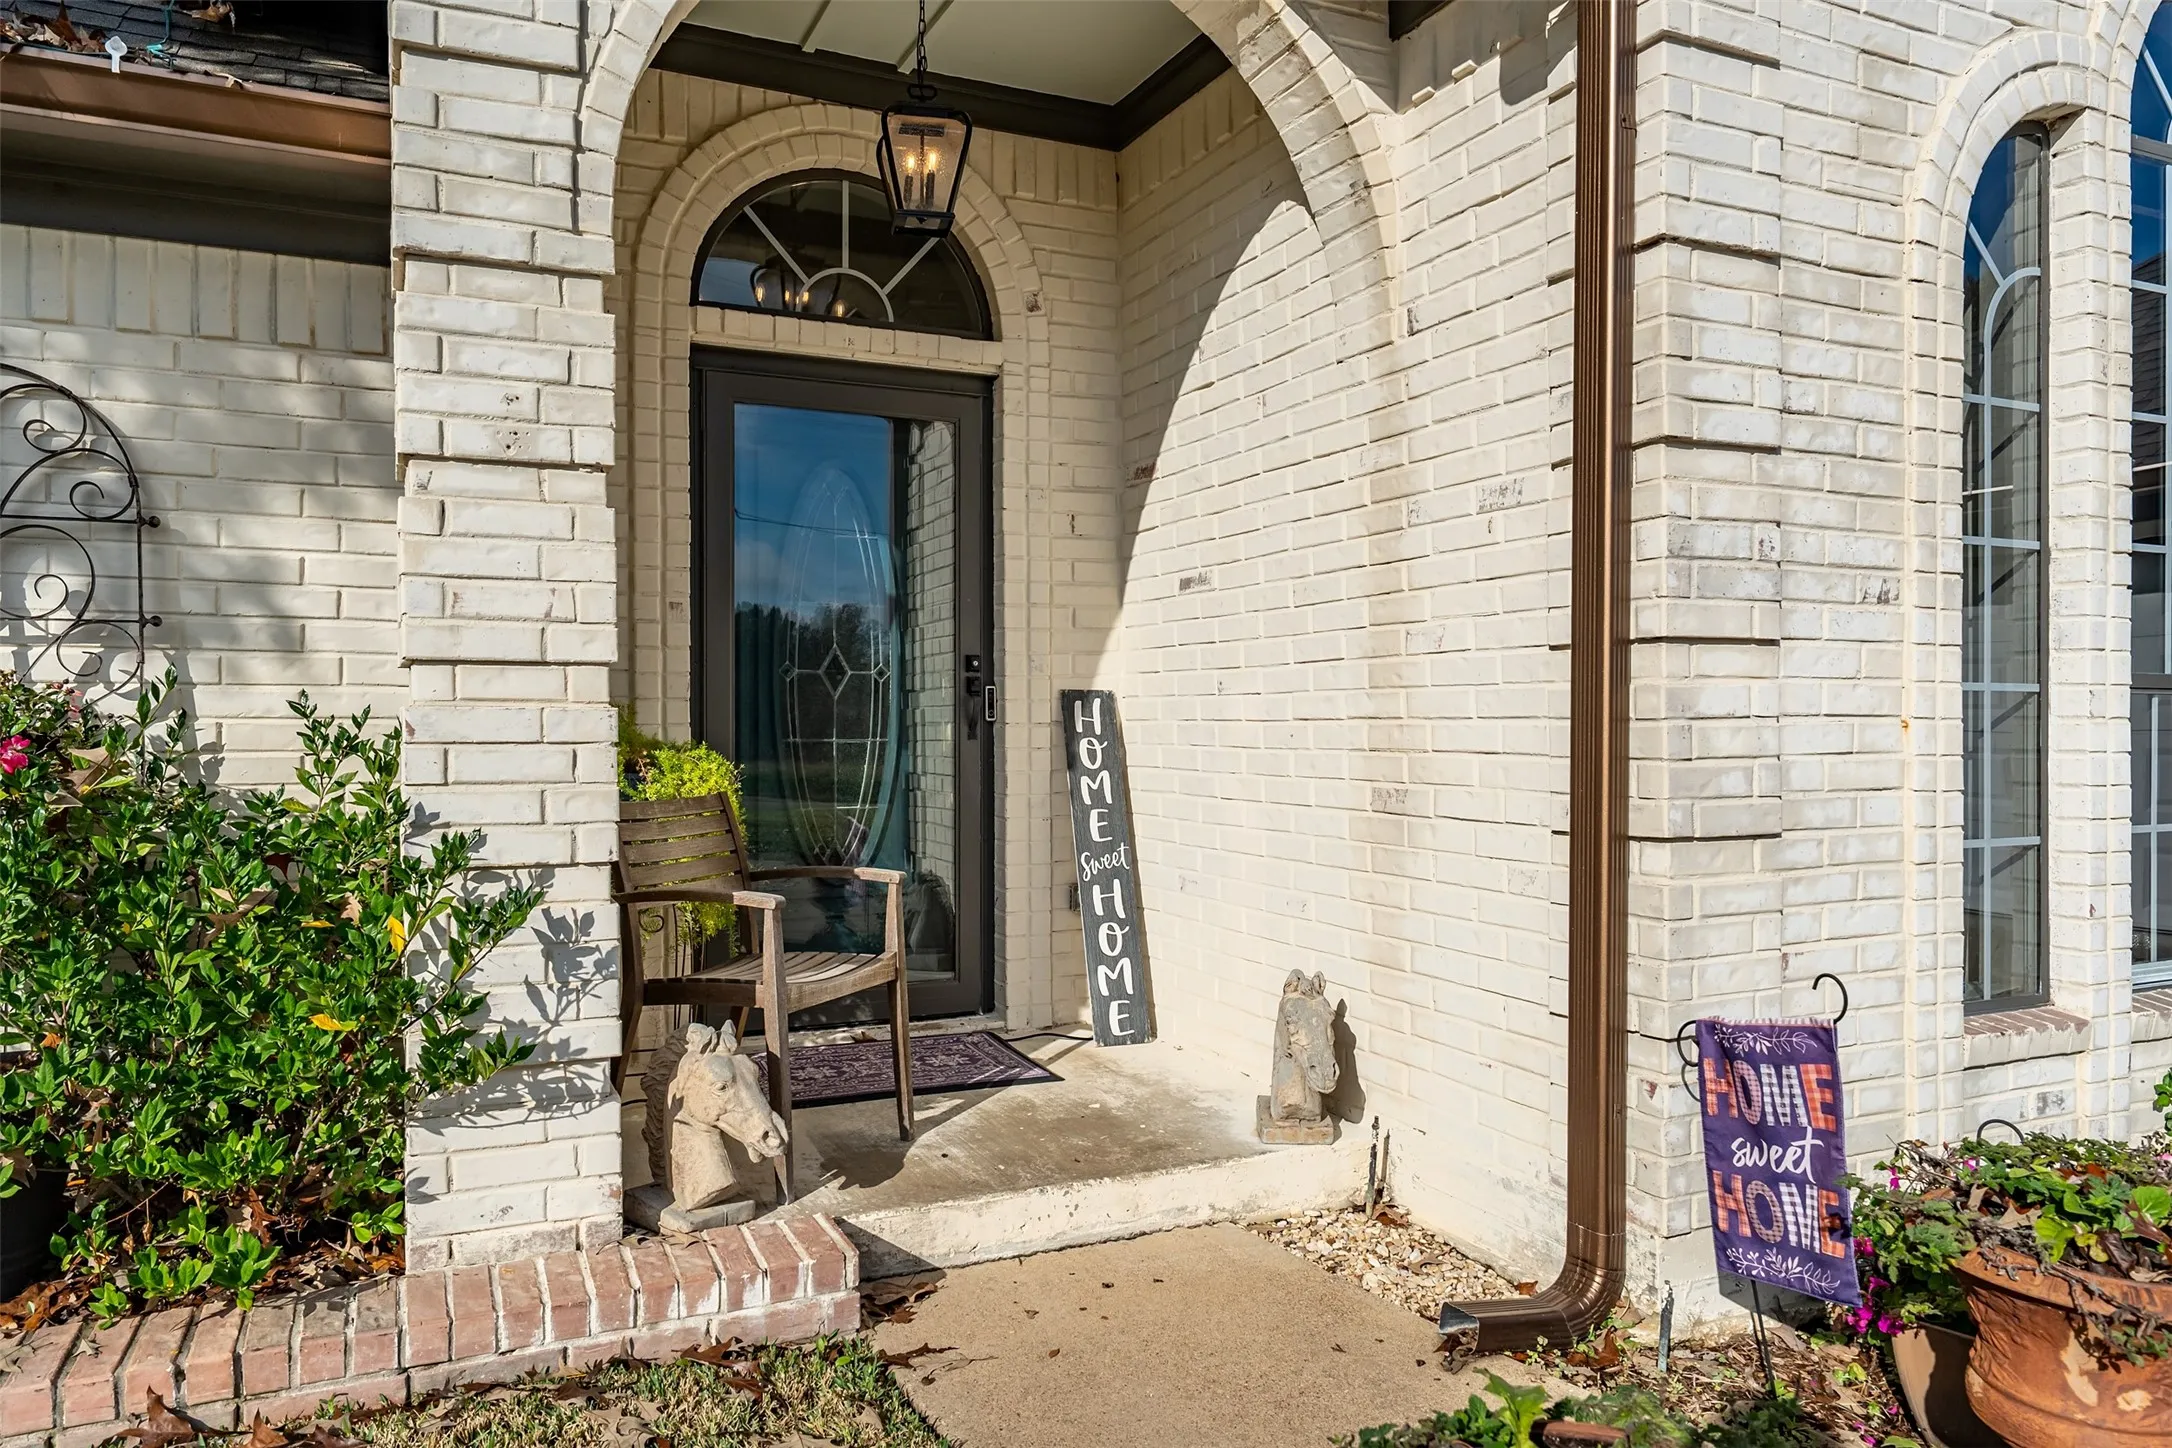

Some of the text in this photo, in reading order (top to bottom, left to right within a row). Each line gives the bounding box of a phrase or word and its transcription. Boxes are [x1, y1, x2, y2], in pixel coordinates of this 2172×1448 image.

[1074, 698, 1113, 842] HOME
[1092, 878, 1135, 1037] HOME
[1703, 1057, 1837, 1132] HOME
[1731, 1126, 1824, 1184] sweet
[1713, 1170, 1846, 1259] HOME
